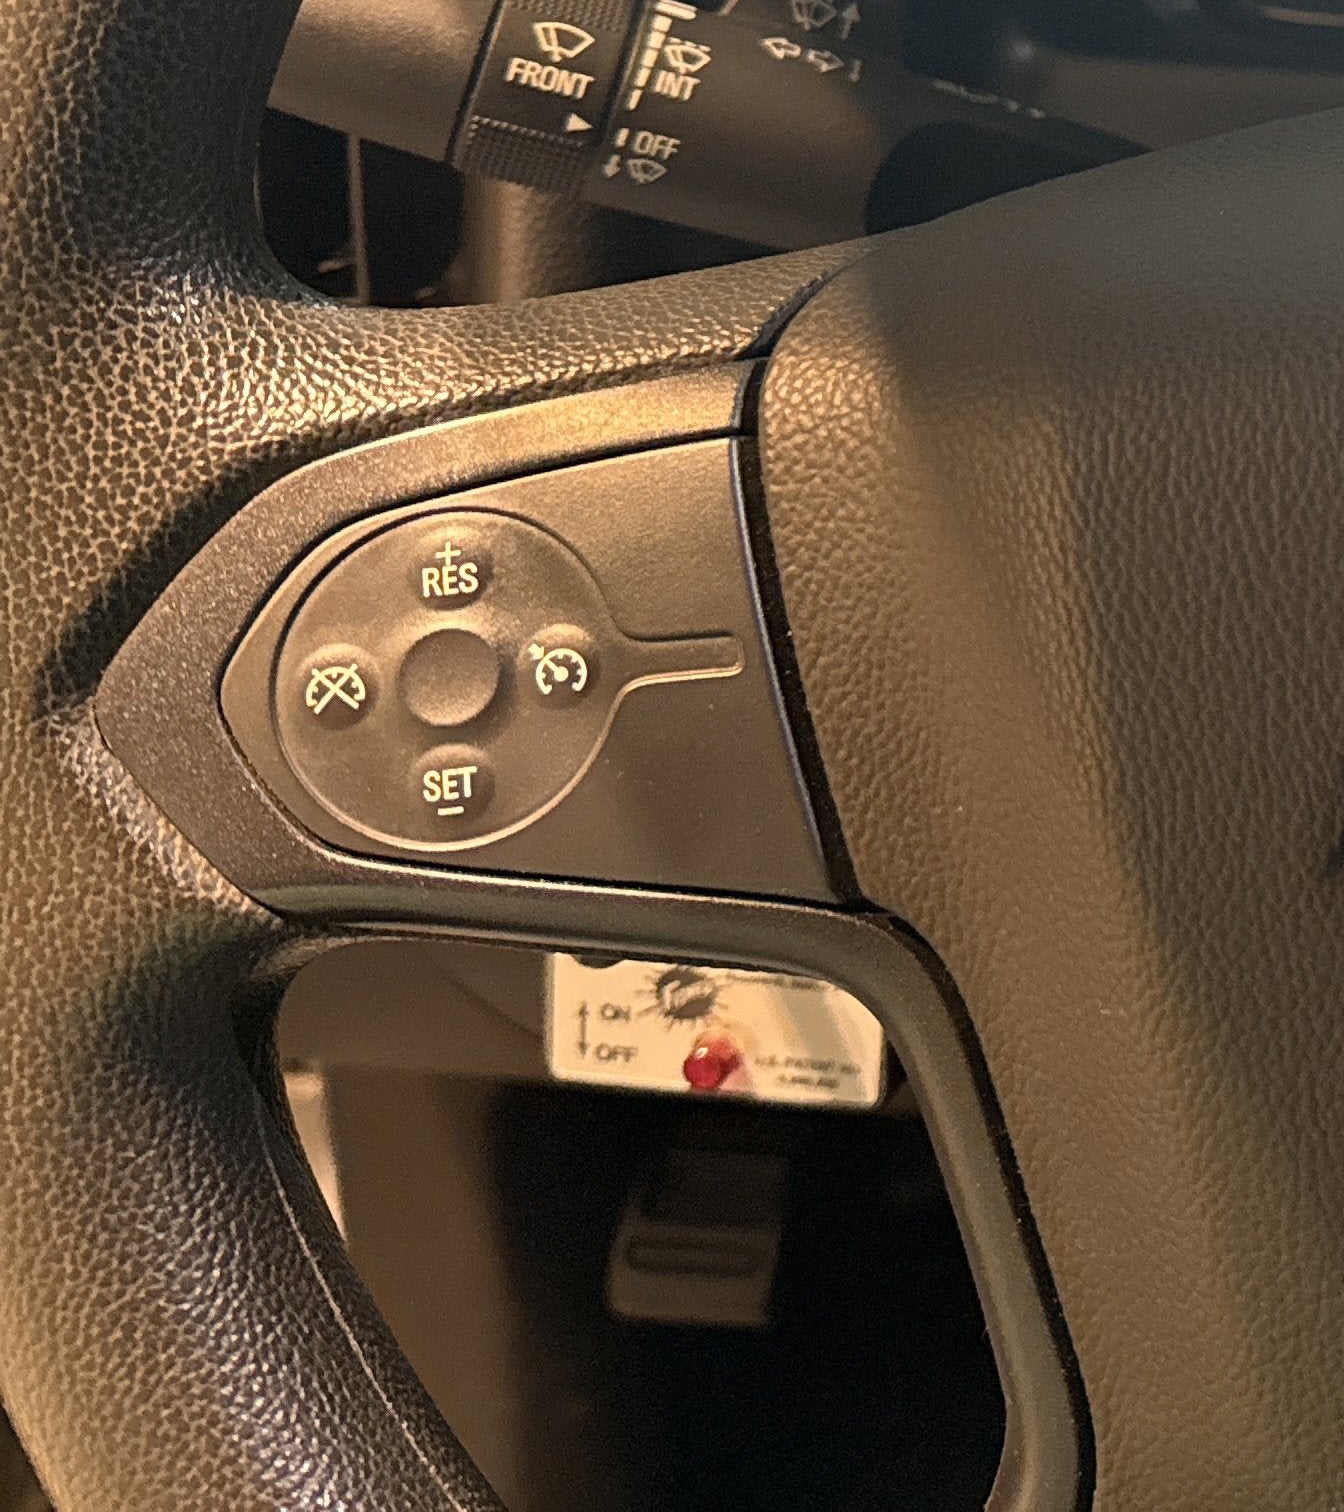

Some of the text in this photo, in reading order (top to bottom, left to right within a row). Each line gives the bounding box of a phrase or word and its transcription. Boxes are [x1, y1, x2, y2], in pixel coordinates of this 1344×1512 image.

[506, 57, 596, 100] FRONT
[654, 70, 701, 101] INT
[632, 130, 682, 160] OFF
[421, 562, 479, 598] RES
[422, 766, 478, 803] SET
[600, 1002, 633, 1024] ON
[593, 1044, 639, 1065] OFF
